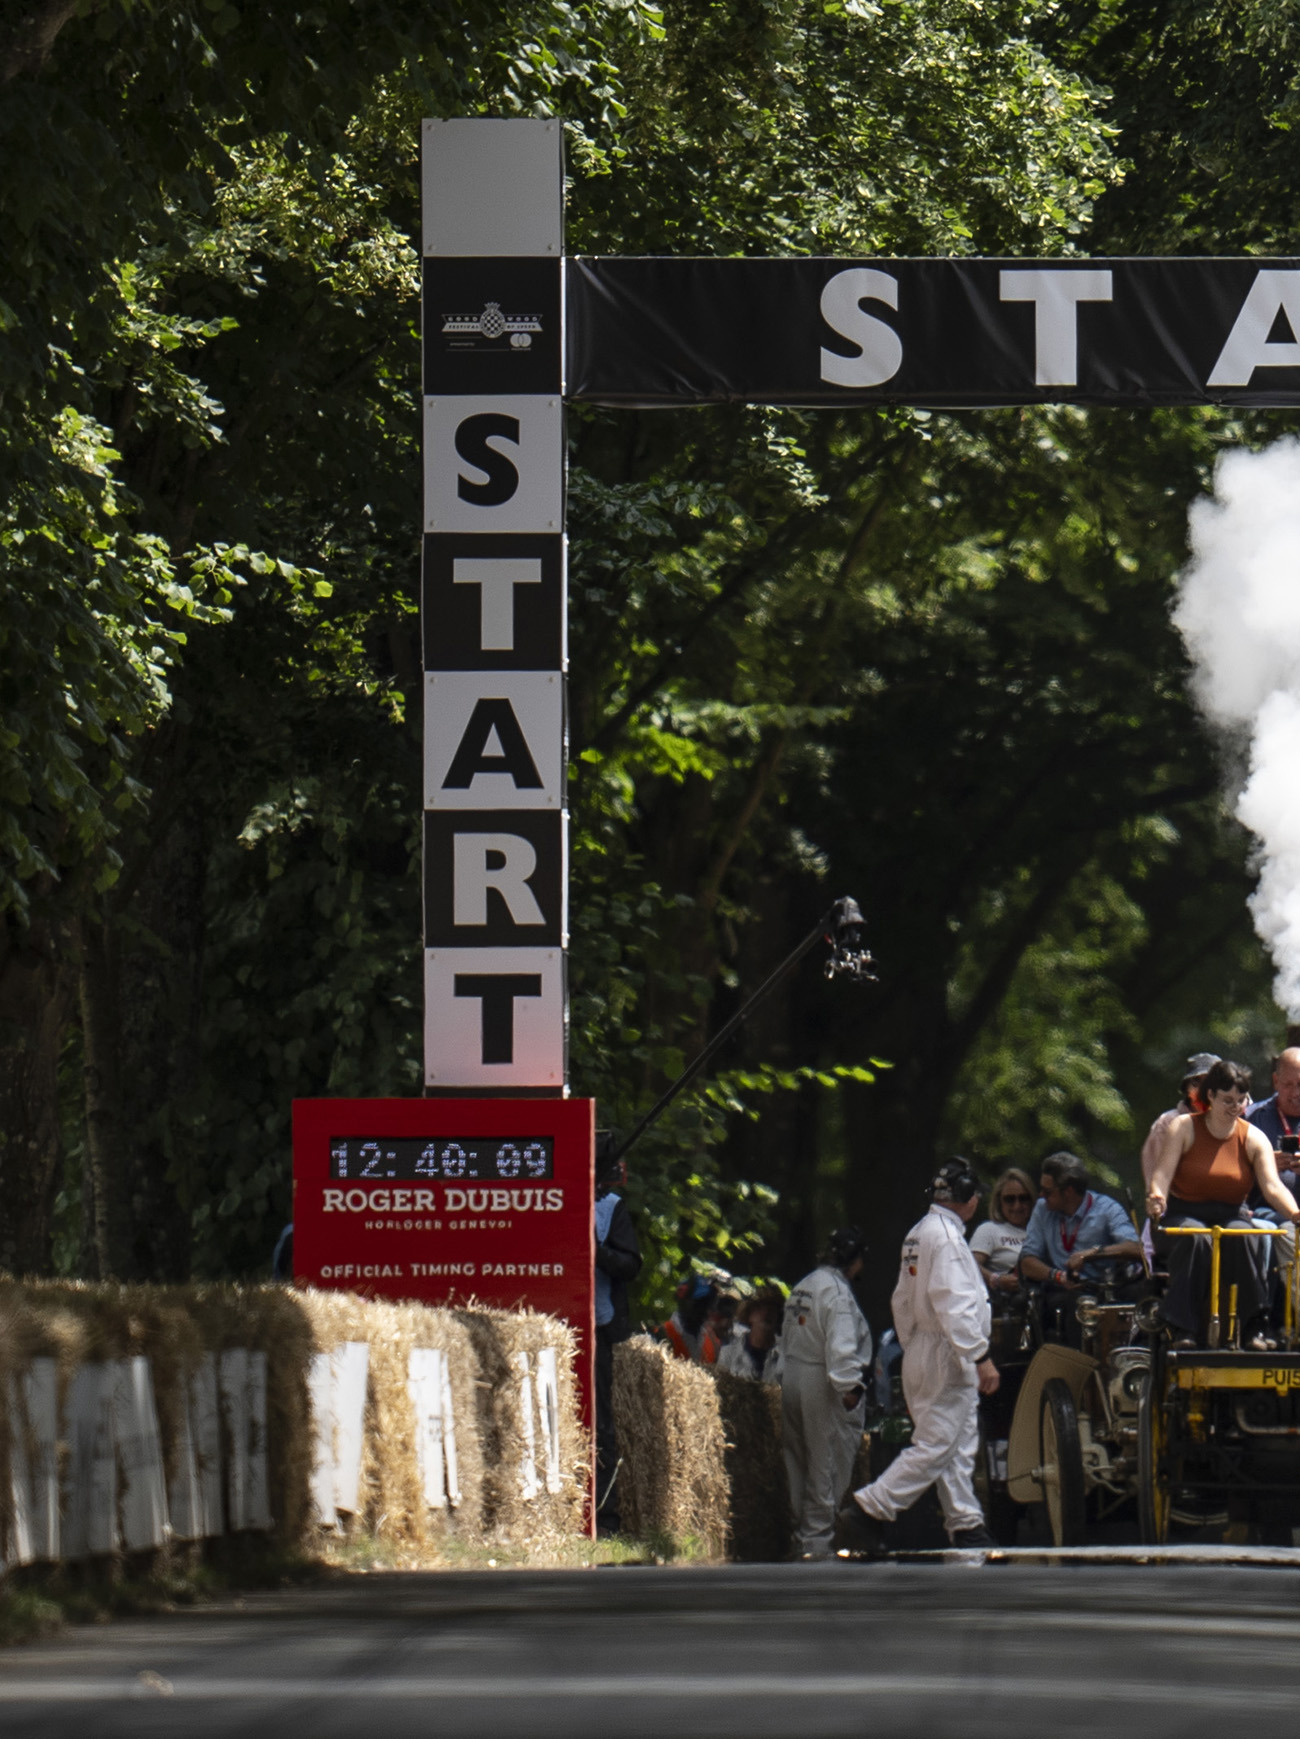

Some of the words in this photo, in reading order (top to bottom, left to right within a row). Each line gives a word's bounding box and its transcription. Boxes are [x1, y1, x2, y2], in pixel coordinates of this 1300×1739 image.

[441, 412, 547, 1065] START
[322, 1189, 436, 1212] ROGER
[444, 1189, 564, 1212] DUBUIS
[365, 1219, 442, 1231] HORLOGER
[320, 1264, 403, 1278] OFFICIAL
[410, 1263, 476, 1277] TIMING
[482, 1264, 565, 1277] PARTNER
